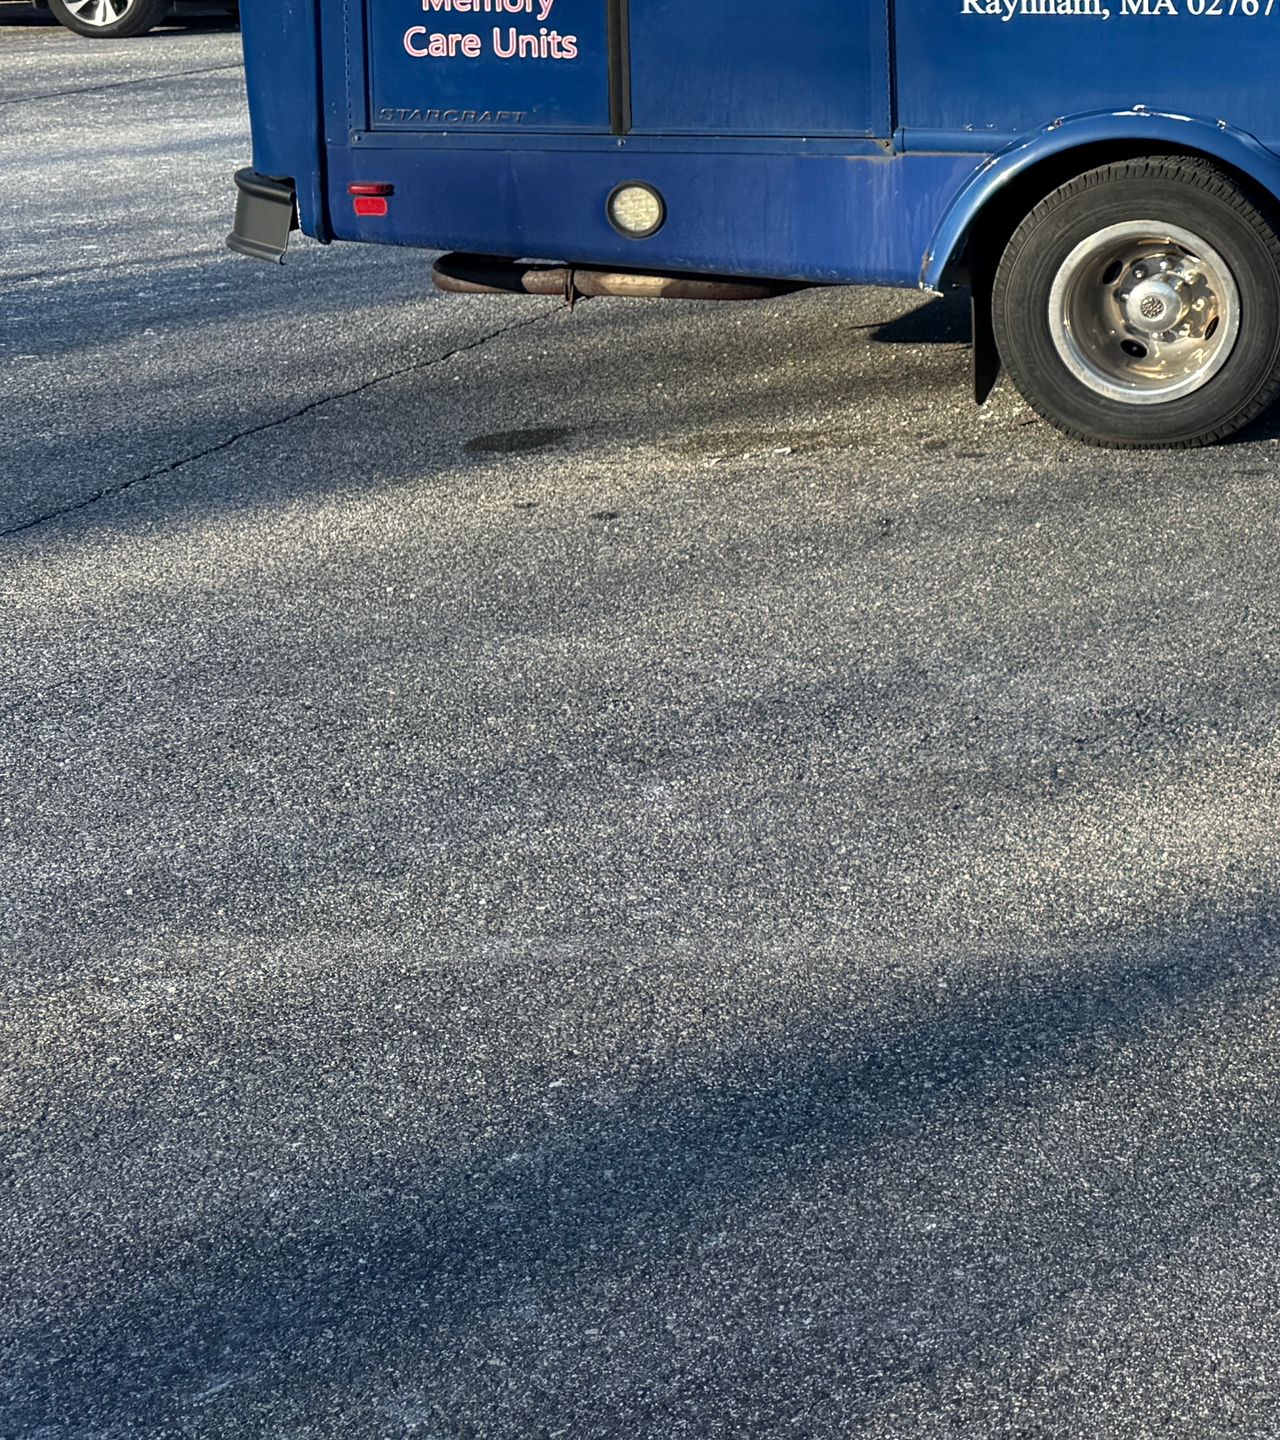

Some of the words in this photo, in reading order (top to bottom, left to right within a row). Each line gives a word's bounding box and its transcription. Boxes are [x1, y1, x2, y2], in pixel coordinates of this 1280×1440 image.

[403, 25, 482, 58] Care
[492, 27, 578, 59] Units
[379, 107, 528, 124] STARCRAFT
